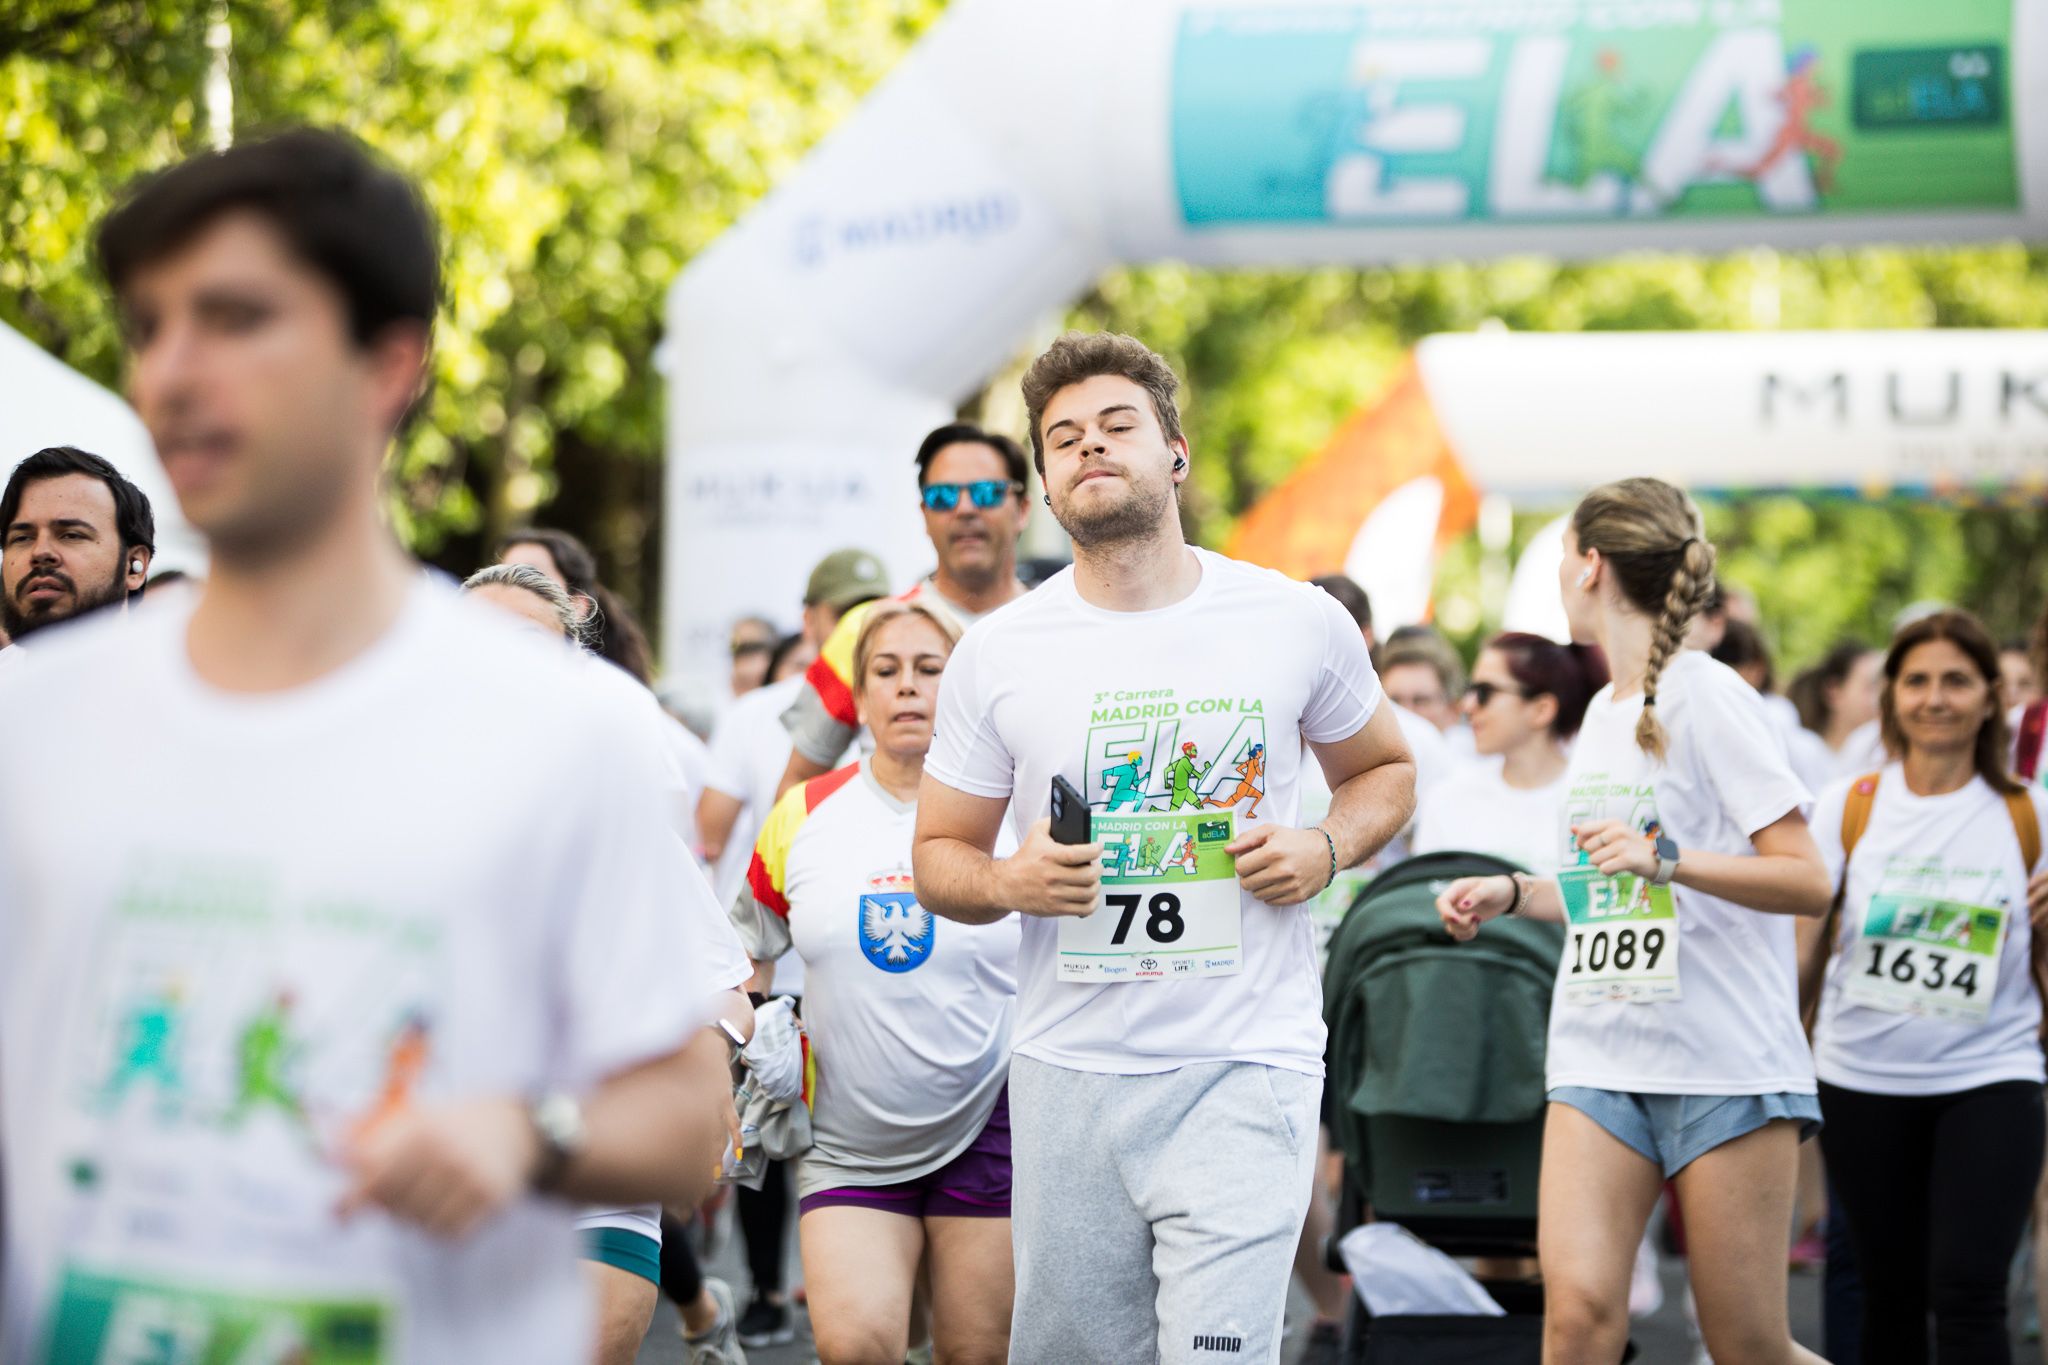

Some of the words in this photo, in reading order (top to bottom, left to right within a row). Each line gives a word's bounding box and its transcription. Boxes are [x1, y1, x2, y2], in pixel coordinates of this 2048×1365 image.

[1325, 27, 1818, 213] ELA
[1090, 702, 1179, 724] MADRID
[1185, 697, 1233, 715] CON
[1238, 698, 1264, 713] LA
[1114, 688, 1174, 702] Carrera
[1084, 716, 1267, 806] ELA
[1098, 821, 1142, 832] MADRID
[1144, 820, 1170, 831] CON
[1173, 820, 1187, 831] LA
[1096, 831, 1198, 877] ELA
[1106, 892, 1185, 945] 78
[1588, 877, 1652, 918] ELA
[1892, 904, 1971, 946] ELA
[1211, 959, 1235, 967] MADRID
[1572, 928, 1665, 974] 1089
[1865, 942, 1978, 997] 1634
[1193, 1335, 1242, 1353] PUMA
